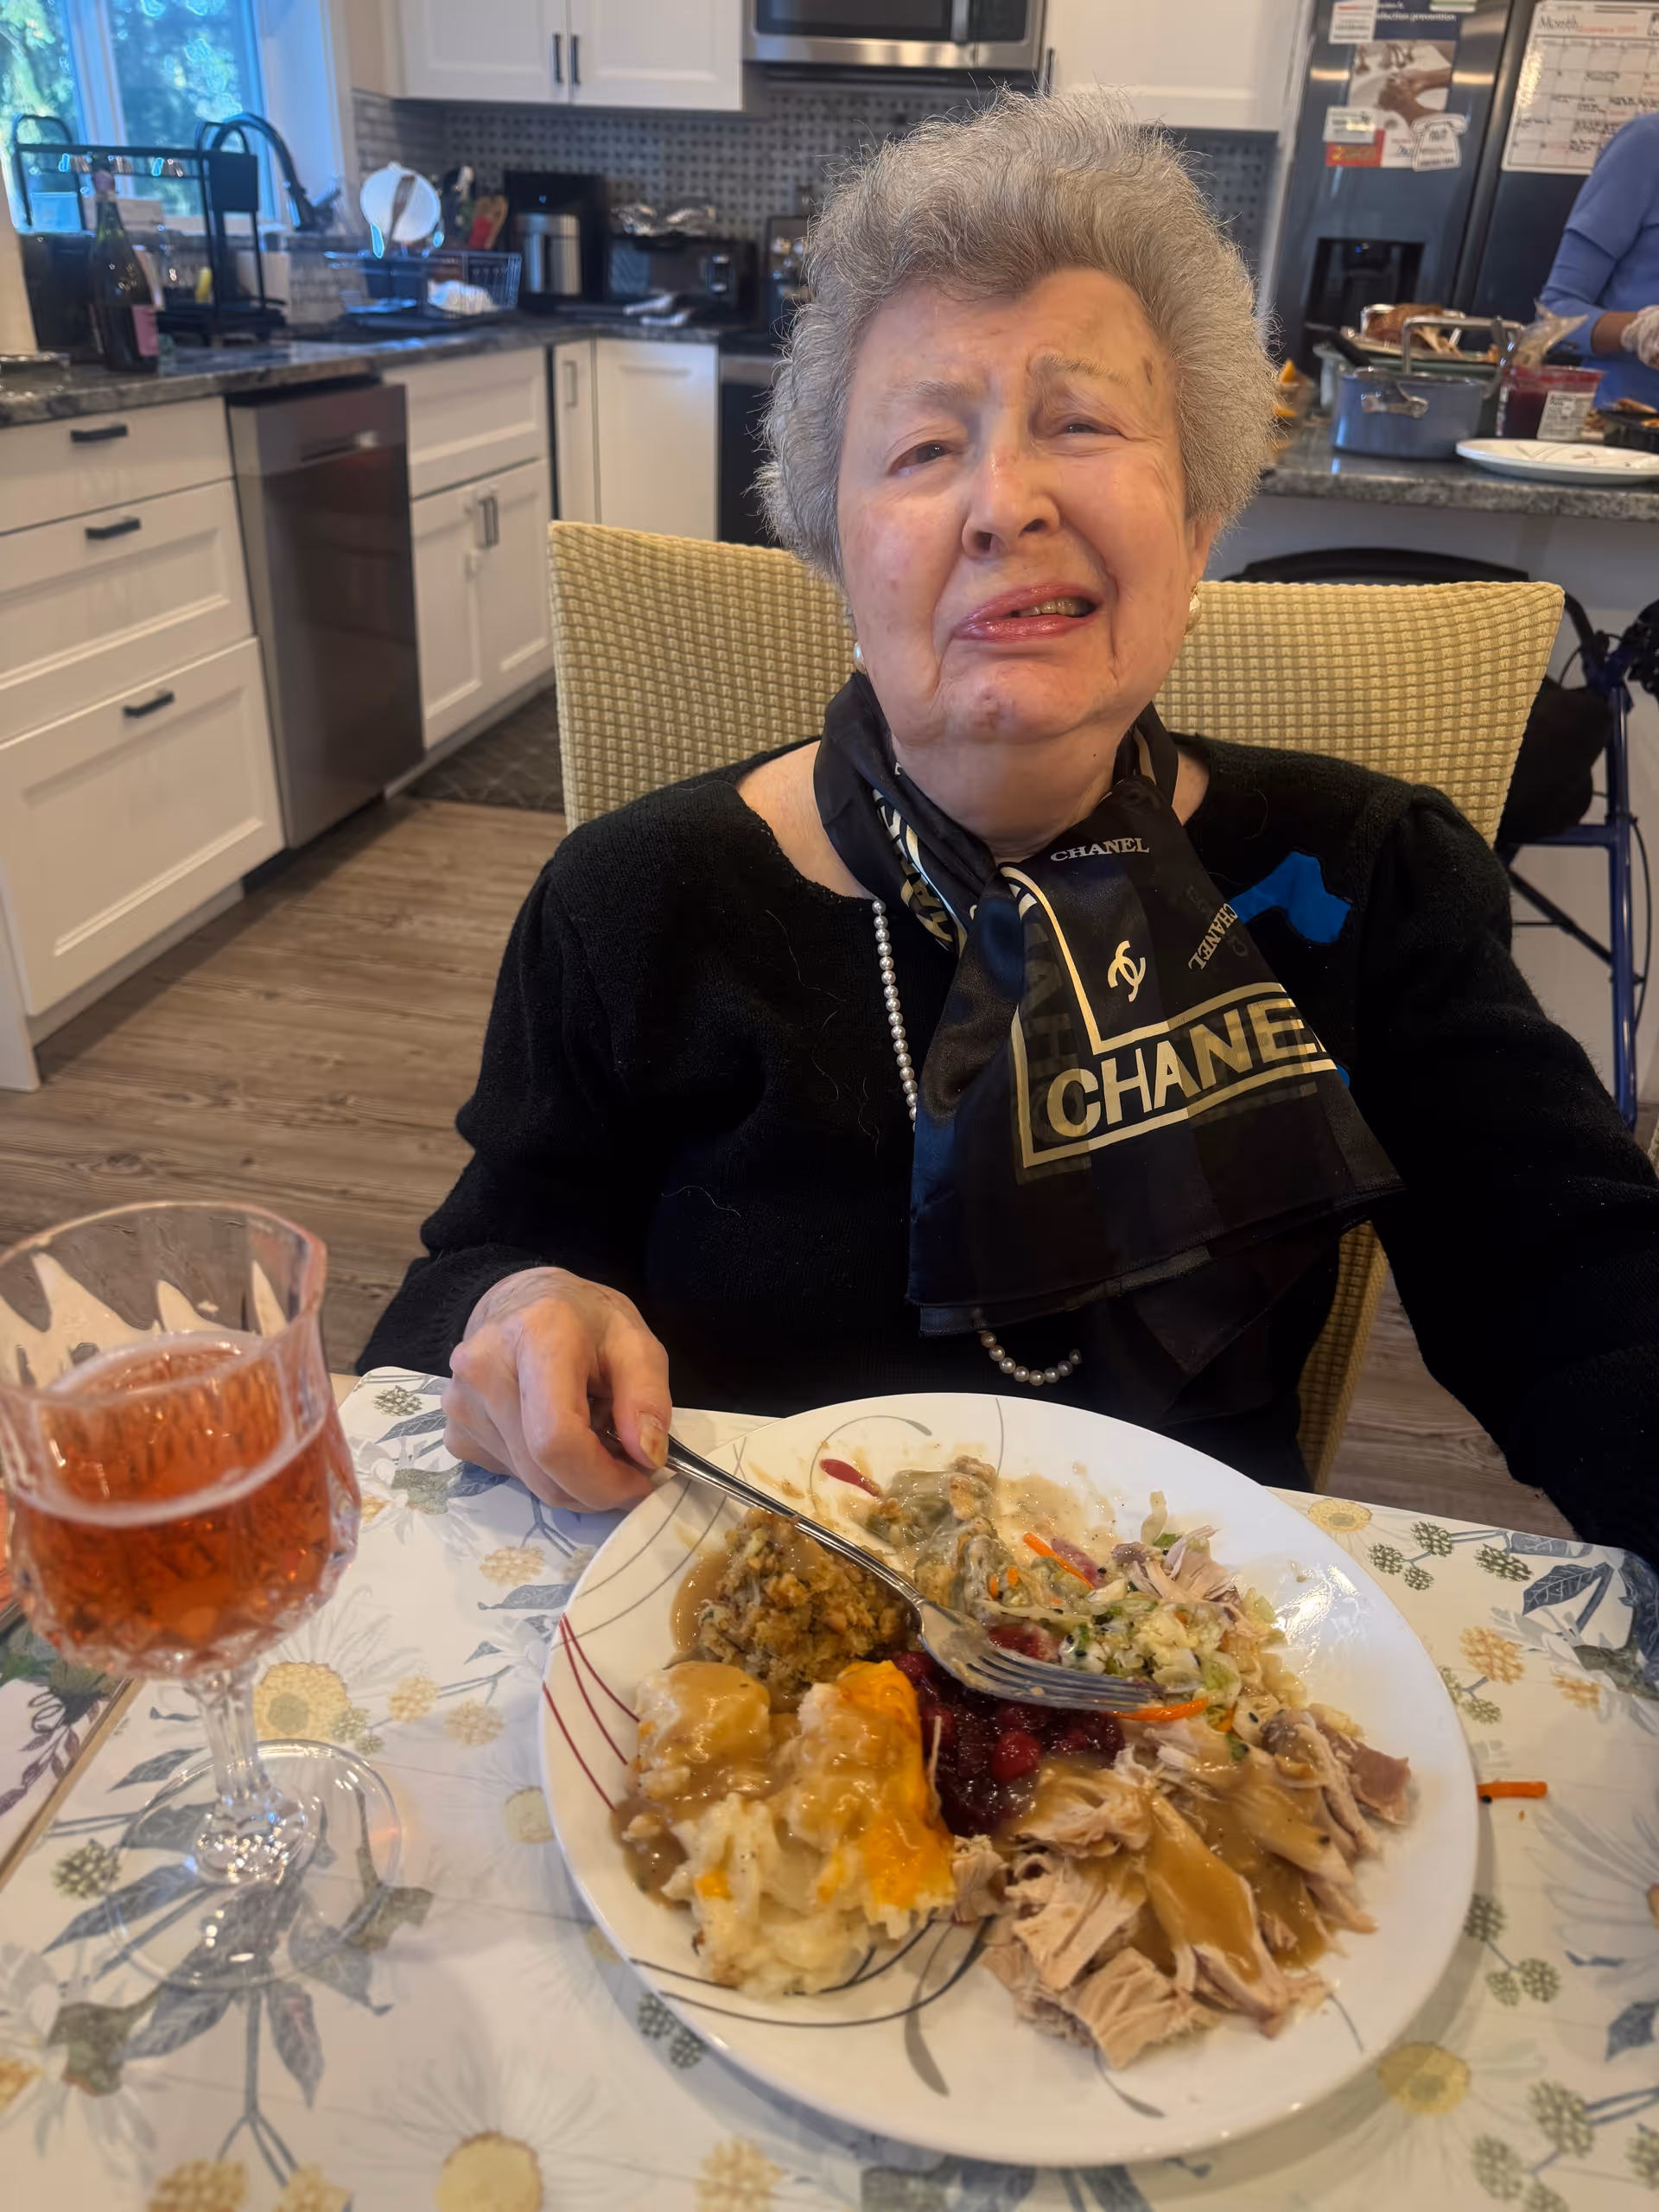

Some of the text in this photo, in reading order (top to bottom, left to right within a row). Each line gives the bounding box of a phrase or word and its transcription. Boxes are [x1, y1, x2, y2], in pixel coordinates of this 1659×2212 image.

[1050, 837, 1150, 861] CHANEL
[1187, 903, 1238, 969] CHANEL
[1046, 997, 1327, 1138] CHANE
